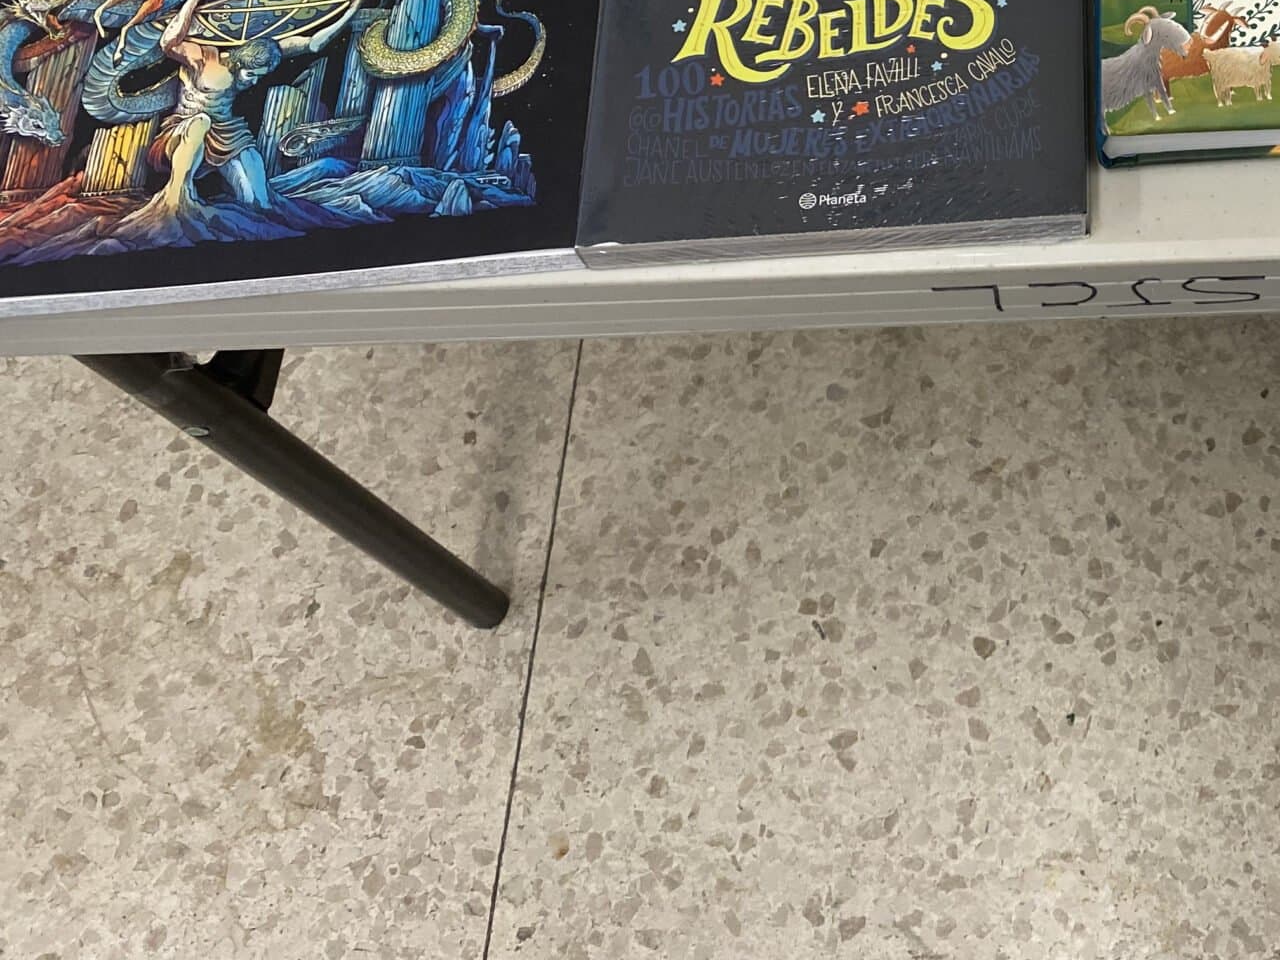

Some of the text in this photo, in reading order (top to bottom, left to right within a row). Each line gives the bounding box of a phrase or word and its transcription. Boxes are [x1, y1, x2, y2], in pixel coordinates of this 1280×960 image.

[806, 68, 863, 99] ELENA
[875, 73, 969, 119] FRANCESCA
[967, 38, 1017, 83] CAVALLO
[661, 85, 803, 134] HISTORIAS
[818, 192, 868, 206] Planeta
